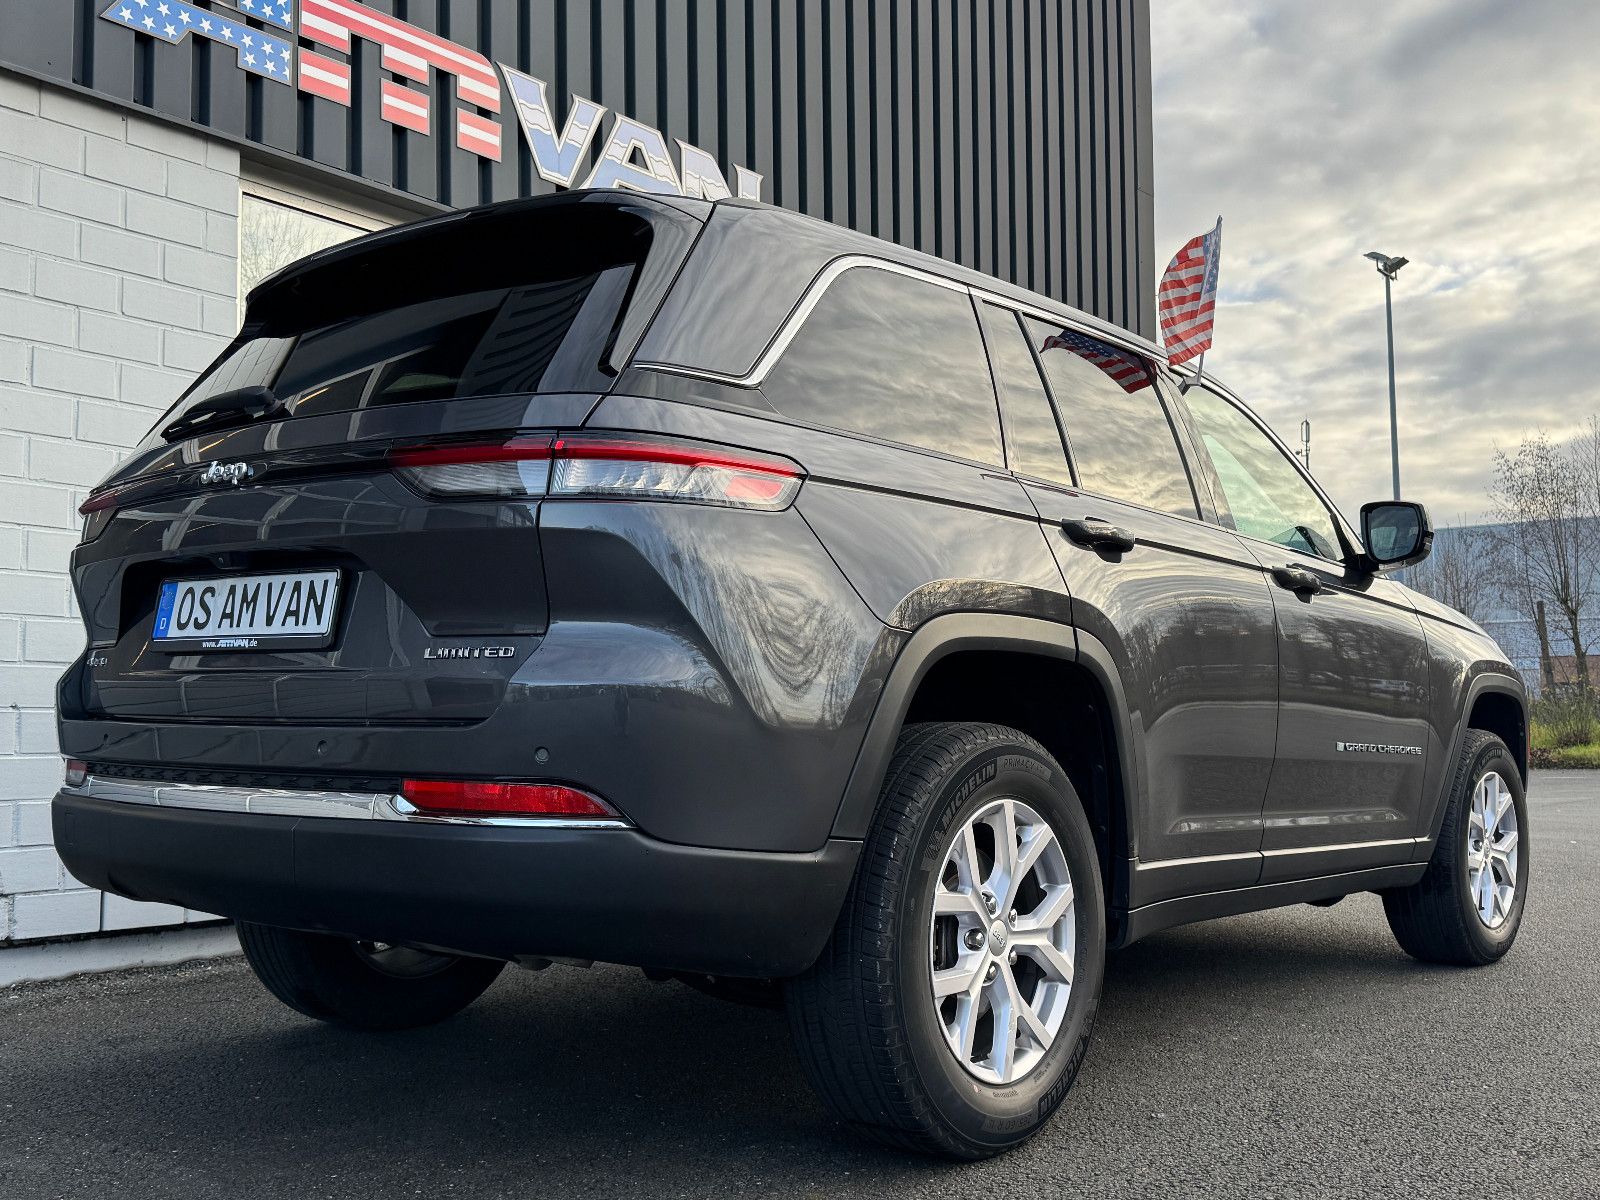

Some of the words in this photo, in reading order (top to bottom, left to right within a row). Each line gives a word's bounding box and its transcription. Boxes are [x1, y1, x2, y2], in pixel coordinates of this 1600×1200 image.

[201, 461, 247, 485] Jeep
[176, 586, 216, 631] OS
[217, 582, 262, 629] AM
[265, 578, 329, 628] VAN
[159, 617, 167, 630] D
[423, 646, 515, 659] LIMITED
[1345, 742, 1377, 752] GRAND
[1378, 744, 1422, 755] CHEROKEE
[941, 762, 996, 827] MICHELIN
